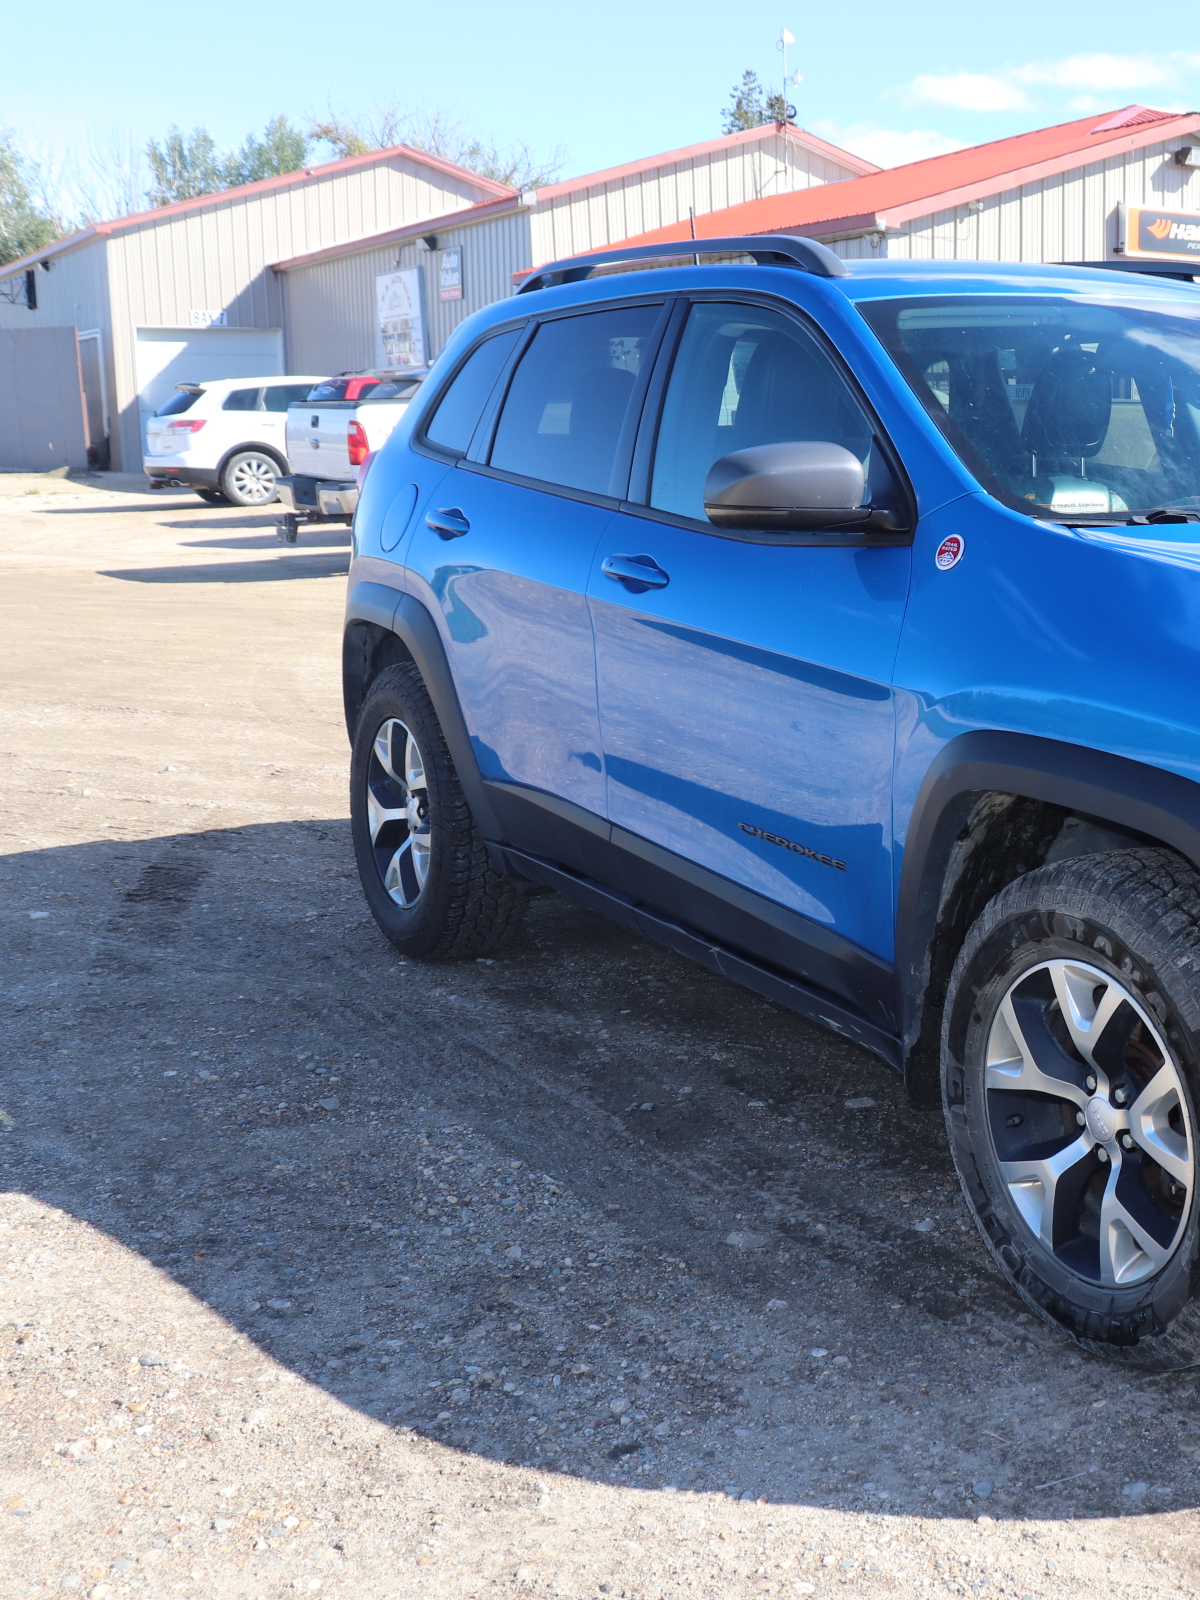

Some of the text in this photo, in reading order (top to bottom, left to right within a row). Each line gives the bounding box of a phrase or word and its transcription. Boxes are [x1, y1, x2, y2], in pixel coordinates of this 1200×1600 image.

[441, 252, 458, 269] Auto
[440, 269, 459, 286] Value
[193, 311, 213, 325] BAY
[738, 822, 847, 873] CHEROKEE
